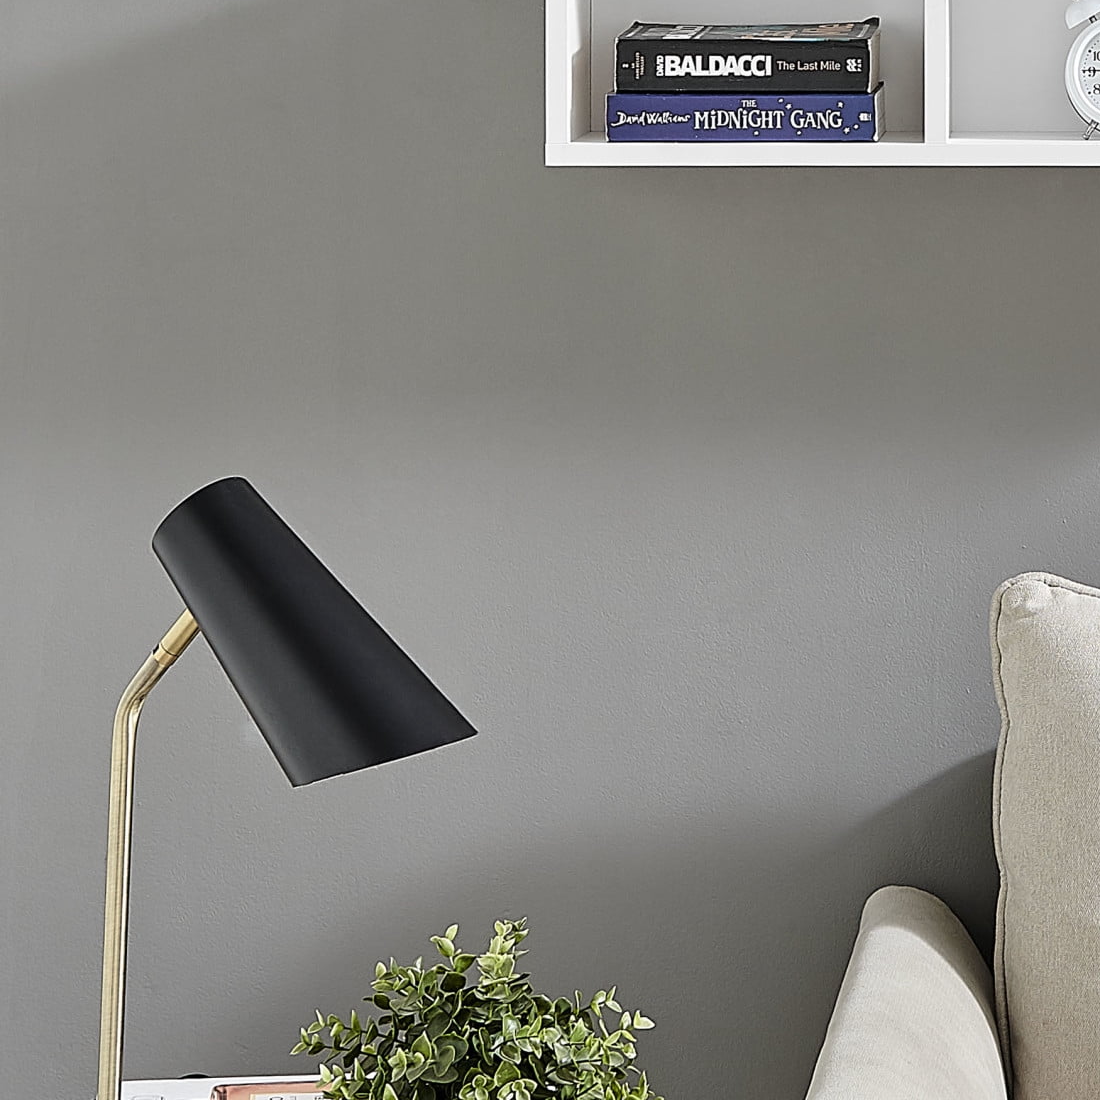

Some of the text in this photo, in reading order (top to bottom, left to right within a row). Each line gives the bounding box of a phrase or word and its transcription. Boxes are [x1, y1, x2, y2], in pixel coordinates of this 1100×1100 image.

[656, 55, 664, 76] DAVID
[664, 55, 772, 77] BALDACCI
[777, 60, 841, 71] The Last Mile
[1088, 66, 1096, 77] 9
[741, 99, 757, 108] THE
[611, 112, 646, 127] David
[789, 109, 843, 130] GANG
